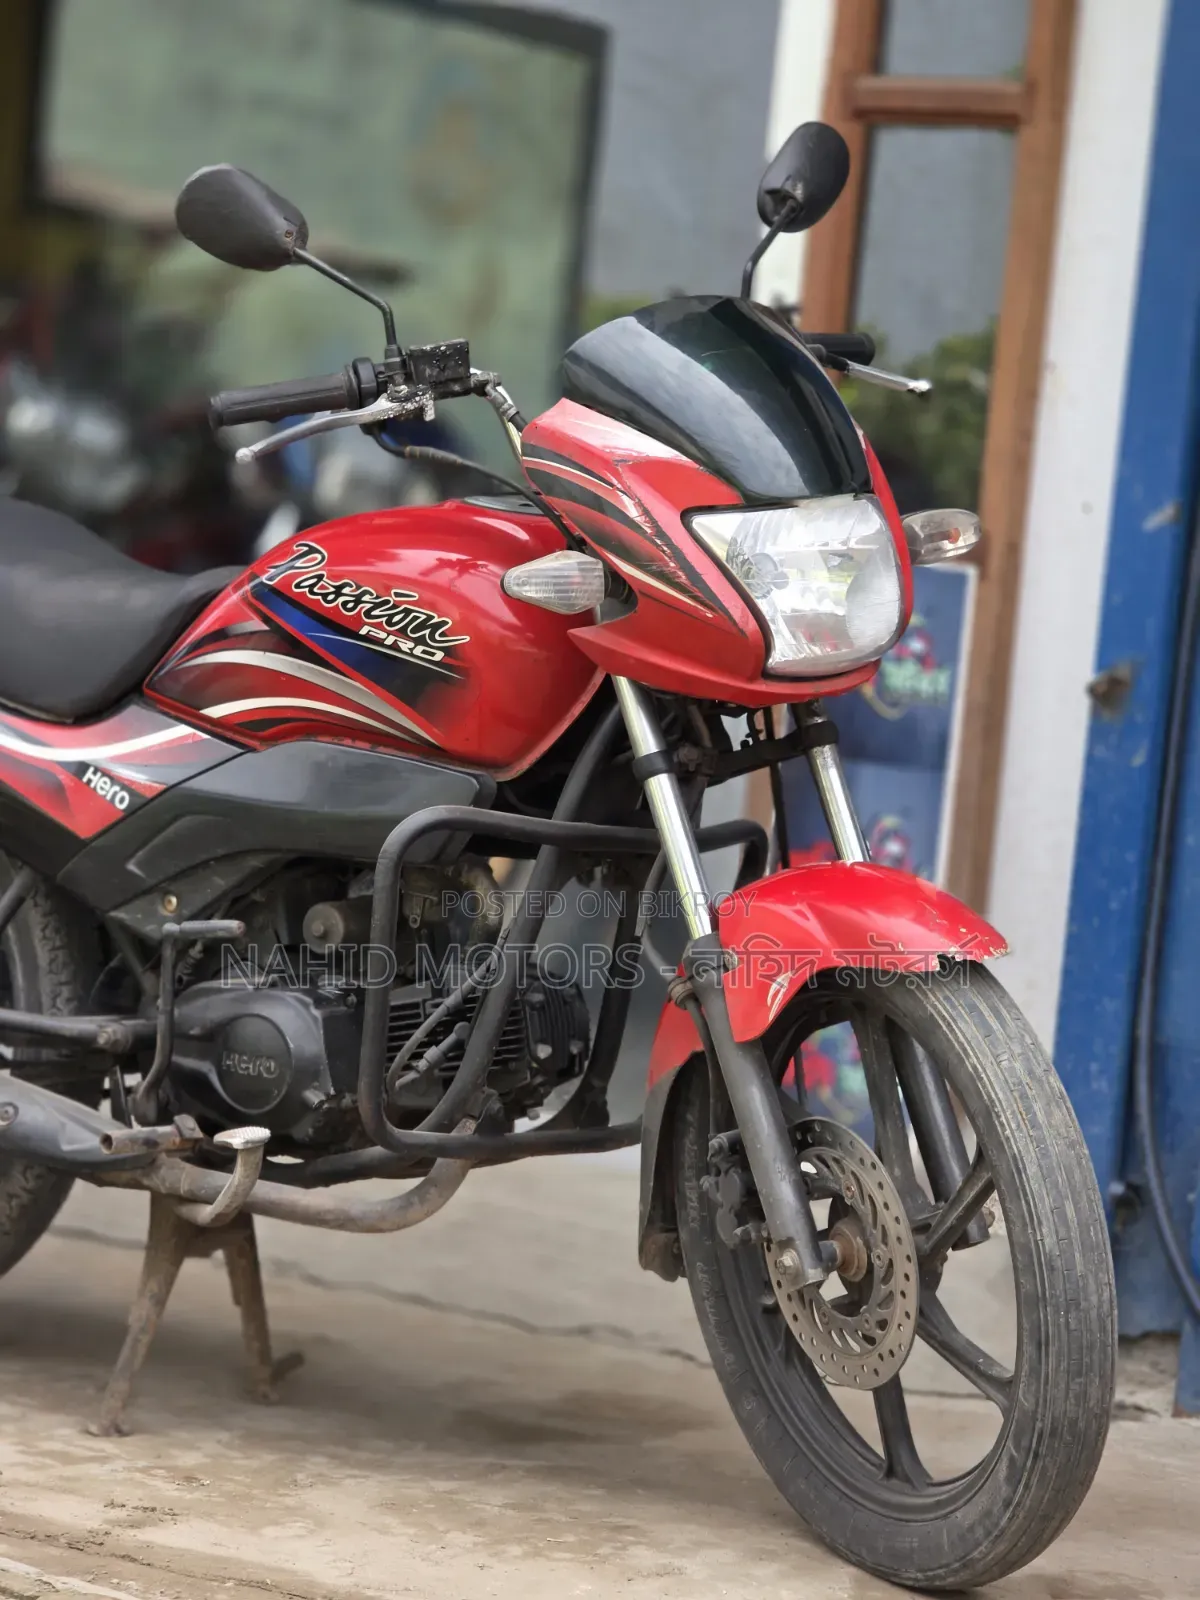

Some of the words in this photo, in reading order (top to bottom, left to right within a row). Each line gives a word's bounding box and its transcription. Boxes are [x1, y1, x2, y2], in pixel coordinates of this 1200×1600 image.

[262, 541, 470, 647] Passion
[359, 624, 445, 662] PRO
[82, 766, 129, 810] Hero
